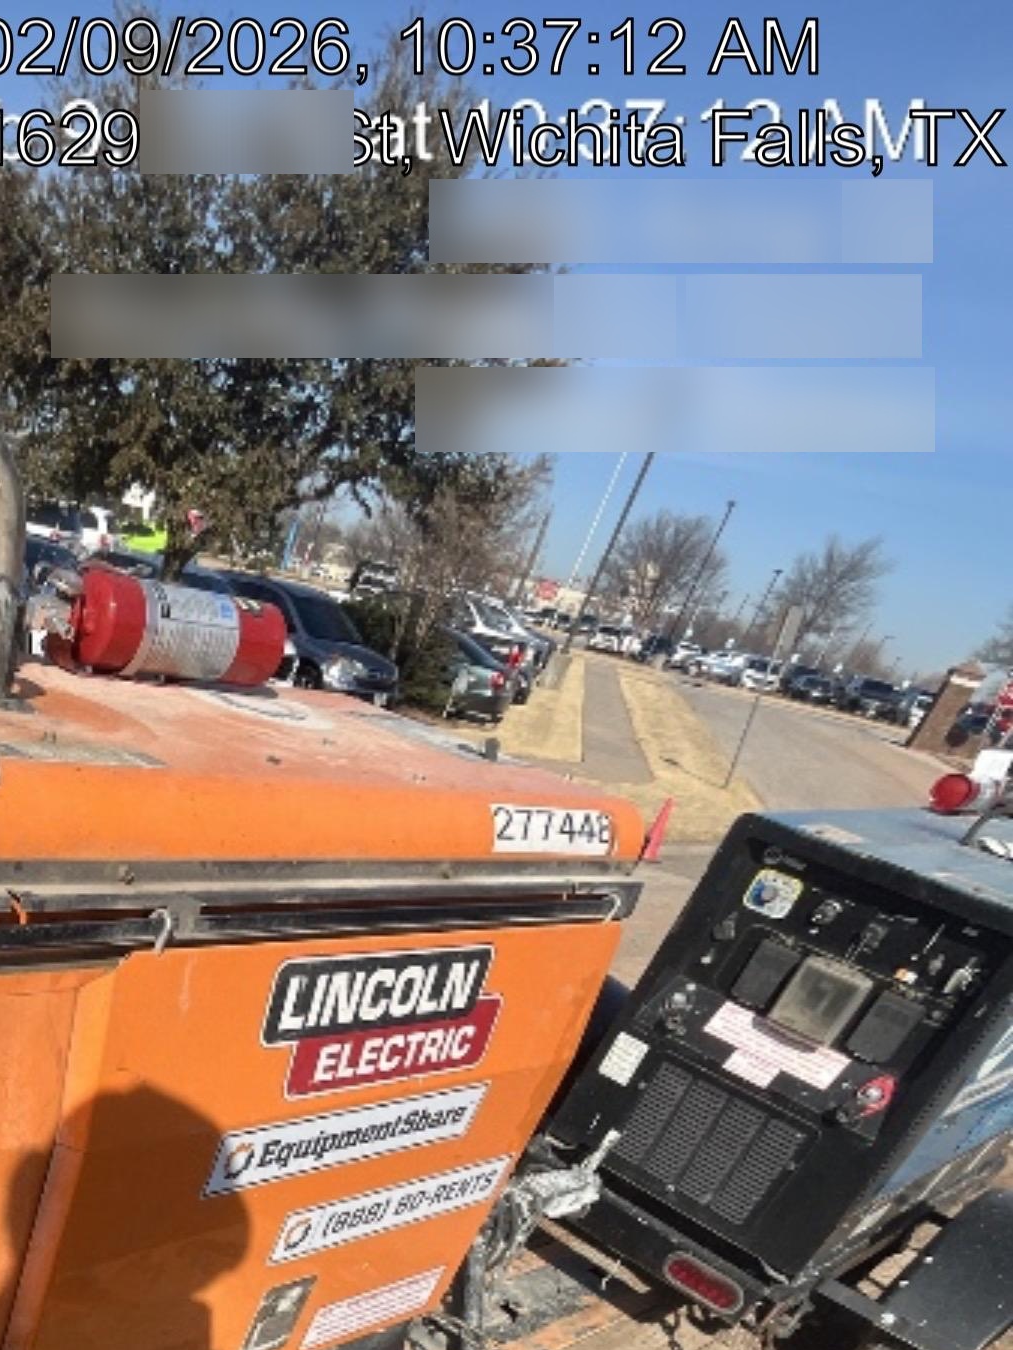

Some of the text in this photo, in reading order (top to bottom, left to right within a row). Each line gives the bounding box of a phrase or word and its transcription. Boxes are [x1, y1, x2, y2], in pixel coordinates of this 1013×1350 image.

[277, 959, 481, 1031] LINCOLN
[313, 1024, 477, 1083] ELECTRIC
[256, 1105, 468, 1168] EquipmentShare
[321, 1200, 389, 1238] (888)
